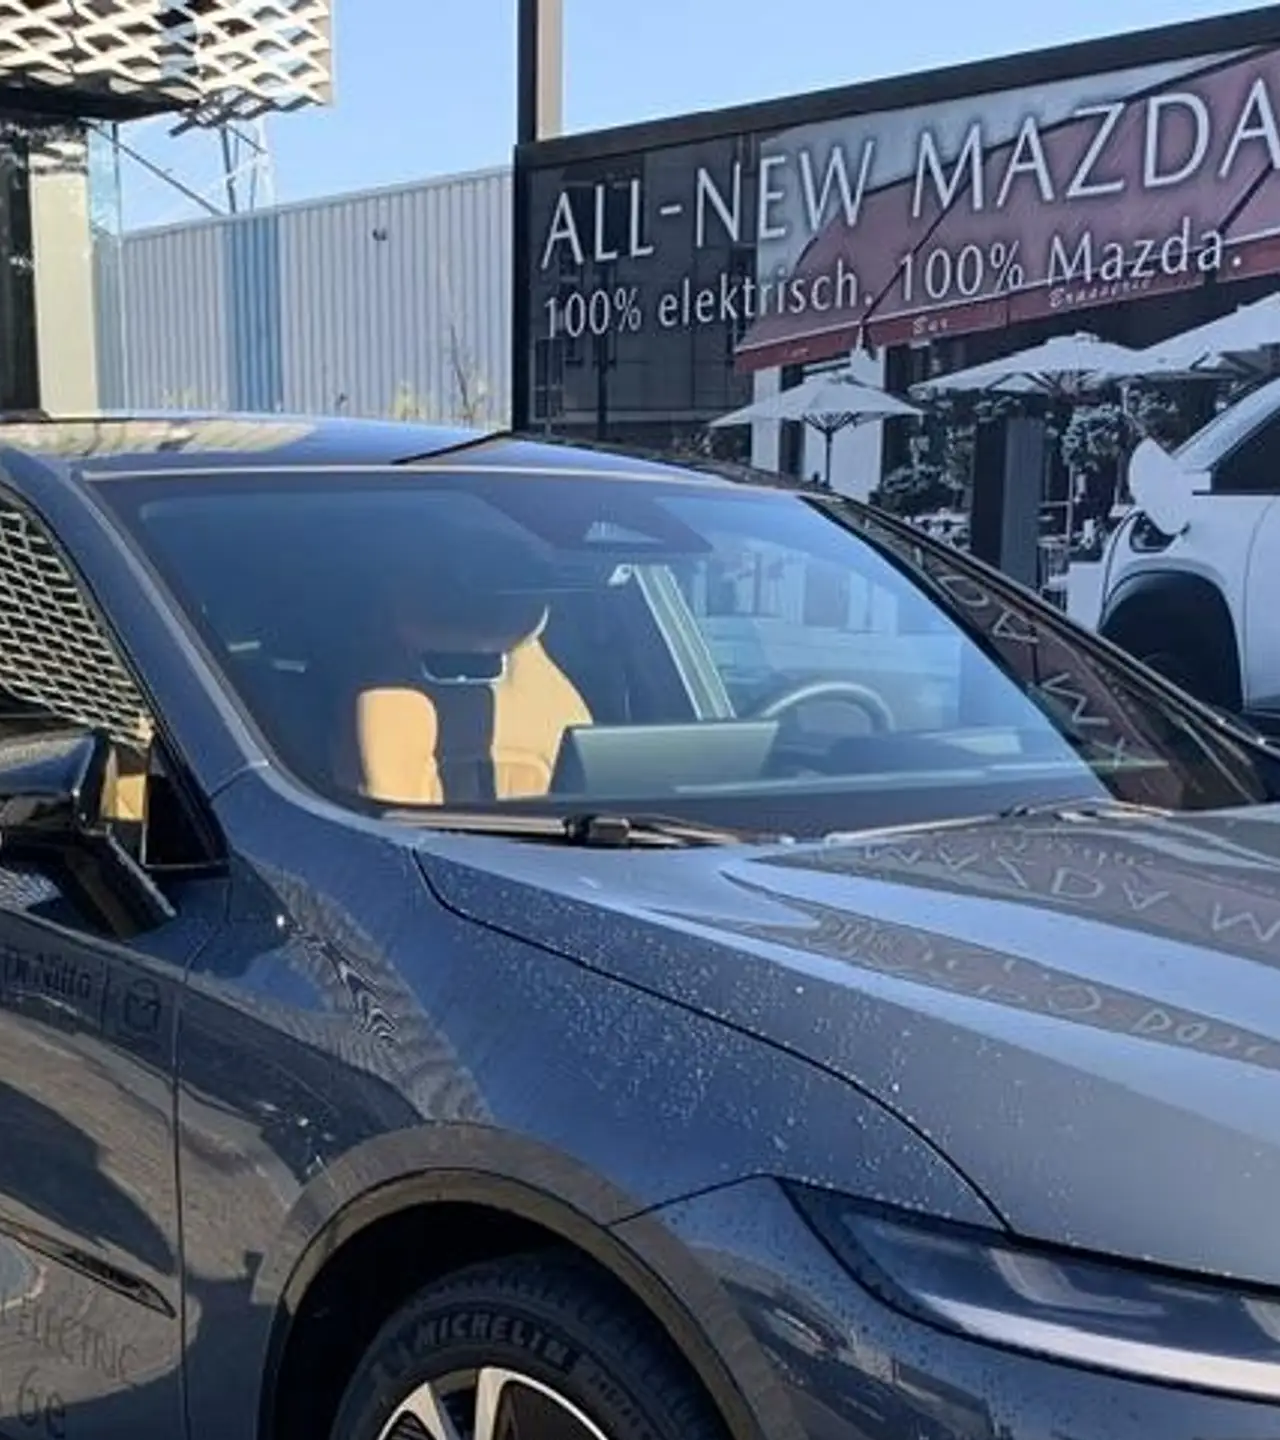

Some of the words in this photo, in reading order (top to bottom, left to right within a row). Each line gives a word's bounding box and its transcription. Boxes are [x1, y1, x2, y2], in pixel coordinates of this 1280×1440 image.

[541, 137, 876, 271] ALL-NEW
[543, 287, 642, 340] 100%
[657, 257, 873, 327] elektrisch.
[899, 238, 1024, 303] 100%
[1048, 216, 1242, 284] Mazda.
[412, 1310, 572, 1367] MICHELIN
